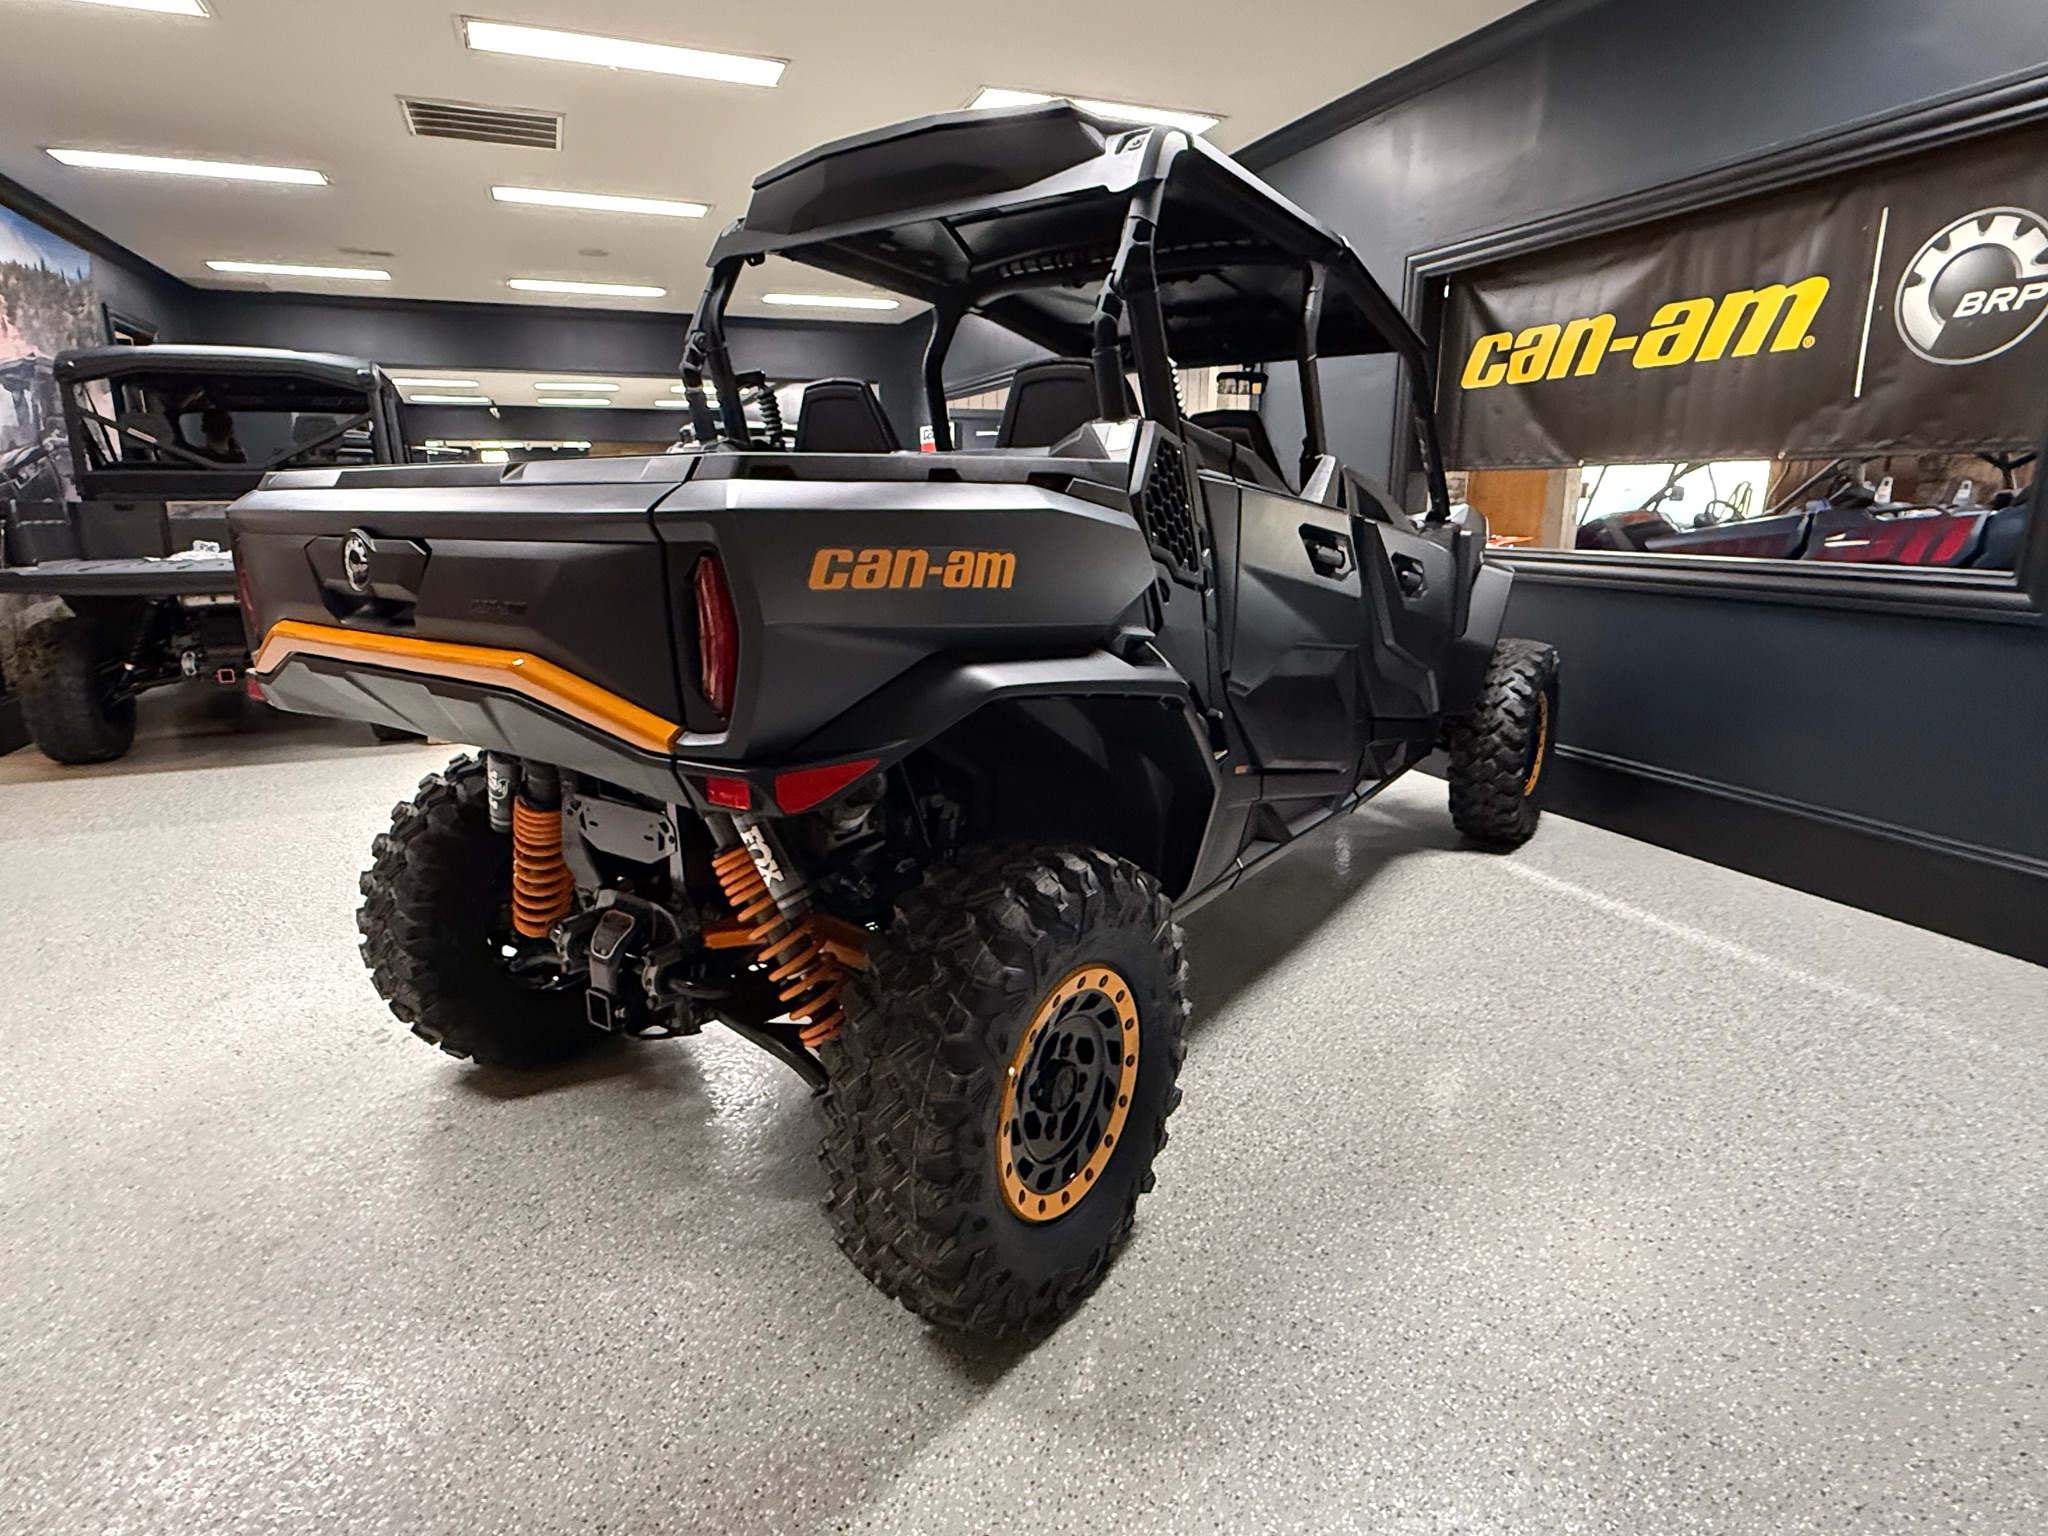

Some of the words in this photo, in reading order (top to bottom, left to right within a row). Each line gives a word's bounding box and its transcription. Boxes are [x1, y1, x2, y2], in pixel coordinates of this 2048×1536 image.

[1952, 282, 2048, 318] BRP
[808, 548, 1016, 590] can-am
[740, 825, 785, 888] FOX
